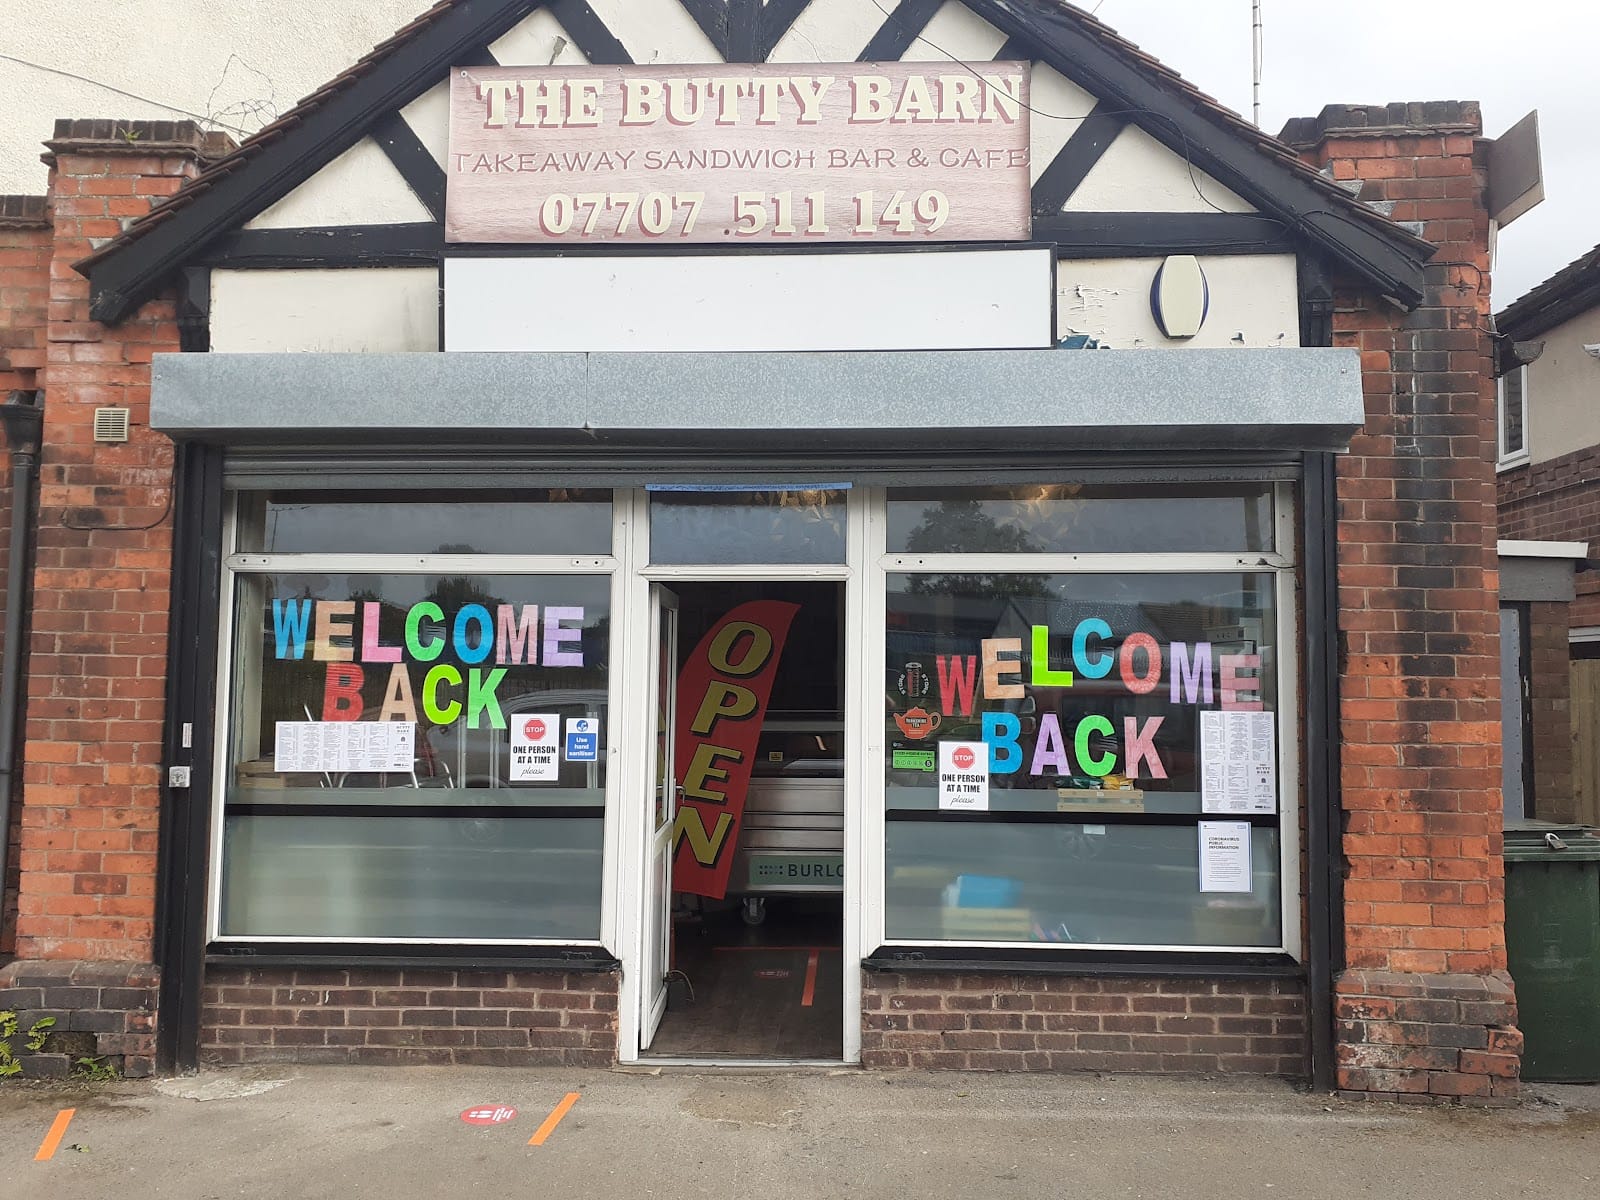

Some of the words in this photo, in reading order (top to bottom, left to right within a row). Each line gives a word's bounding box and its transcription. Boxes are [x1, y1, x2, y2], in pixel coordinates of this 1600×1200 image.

[476, 79, 604, 129] THE
[619, 76, 834, 127] BUTTY
[848, 75, 1023, 125] BARN
[452, 150, 636, 173] TAKEAWAY
[643, 149, 816, 170] SANDWICH
[828, 148, 897, 169] BAR
[906, 147, 929, 169] &
[539, 191, 706, 238] 07707
[734, 190, 830, 237] 511
[852, 189, 950, 236] 149
[272, 598, 585, 667] WELCOME
[936, 617, 1264, 717] WELCOME
[322, 662, 508, 729] BACK
[513, 745, 527, 754] ONE
[528, 745, 556, 754] PERSON
[517, 756, 527, 764] AT
[527, 756, 533, 764] A
[534, 756, 551, 764] TIME
[673, 620, 774, 870] OPEN
[981, 711, 1168, 779] BACK
[520, 765, 545, 777] please
[942, 774, 956, 782] ONE
[957, 774, 986, 782] PERSON
[946, 784, 955, 792] AT
[956, 784, 962, 792] A
[963, 784, 981, 792] TIME
[950, 795, 975, 806] please
